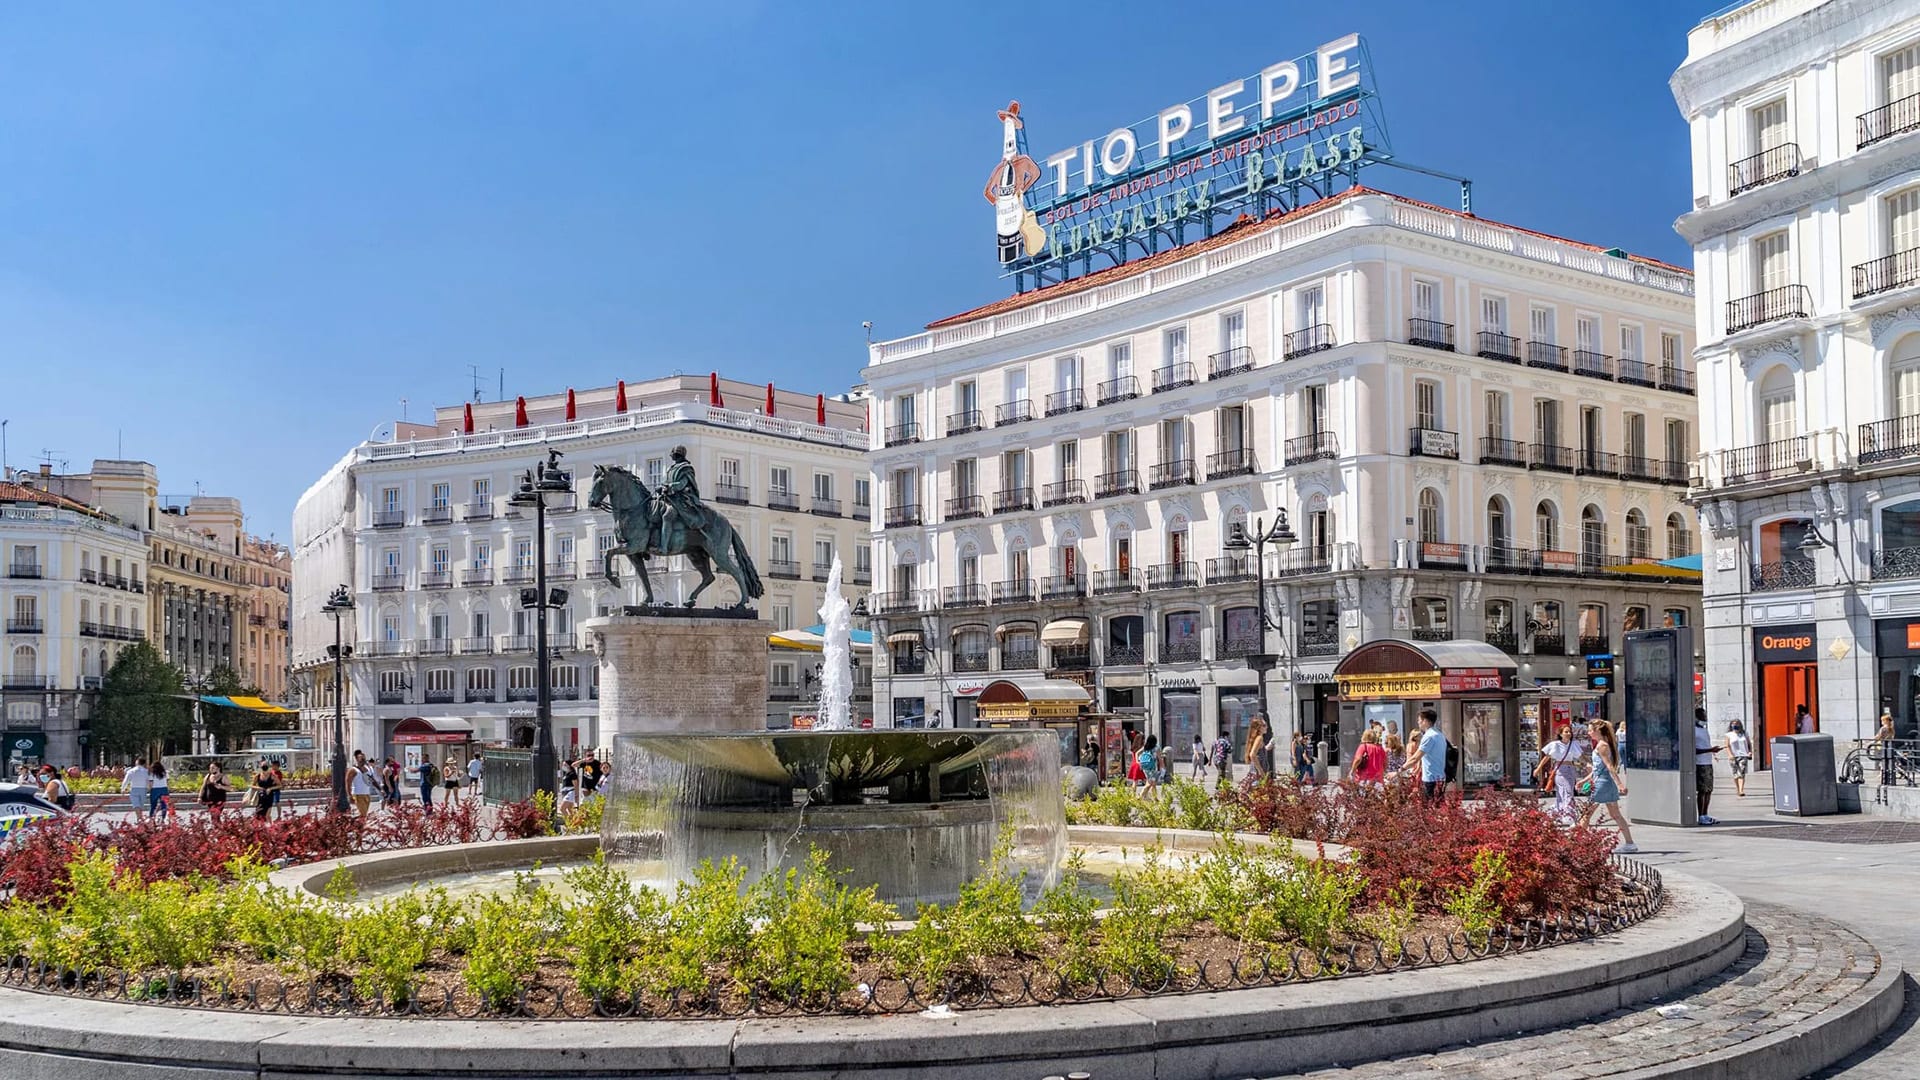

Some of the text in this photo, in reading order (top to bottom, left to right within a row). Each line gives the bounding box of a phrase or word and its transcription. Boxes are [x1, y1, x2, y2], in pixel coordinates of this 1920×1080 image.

[1047, 32, 1360, 196] TIO PEPE
[1045, 100, 1359, 225] SOL DE ANDALUCIA EMBOTELLADO
[1050, 126, 1365, 259] GONZALEZ BYASS
[1762, 635, 1812, 651] Orange
[1160, 678, 1197, 687] SEPHORA
[1352, 681, 1376, 693] TOURS
[1378, 681, 1384, 692] &
[1387, 680, 1420, 692] TICKETS
[10, 806, 27, 815] 112
